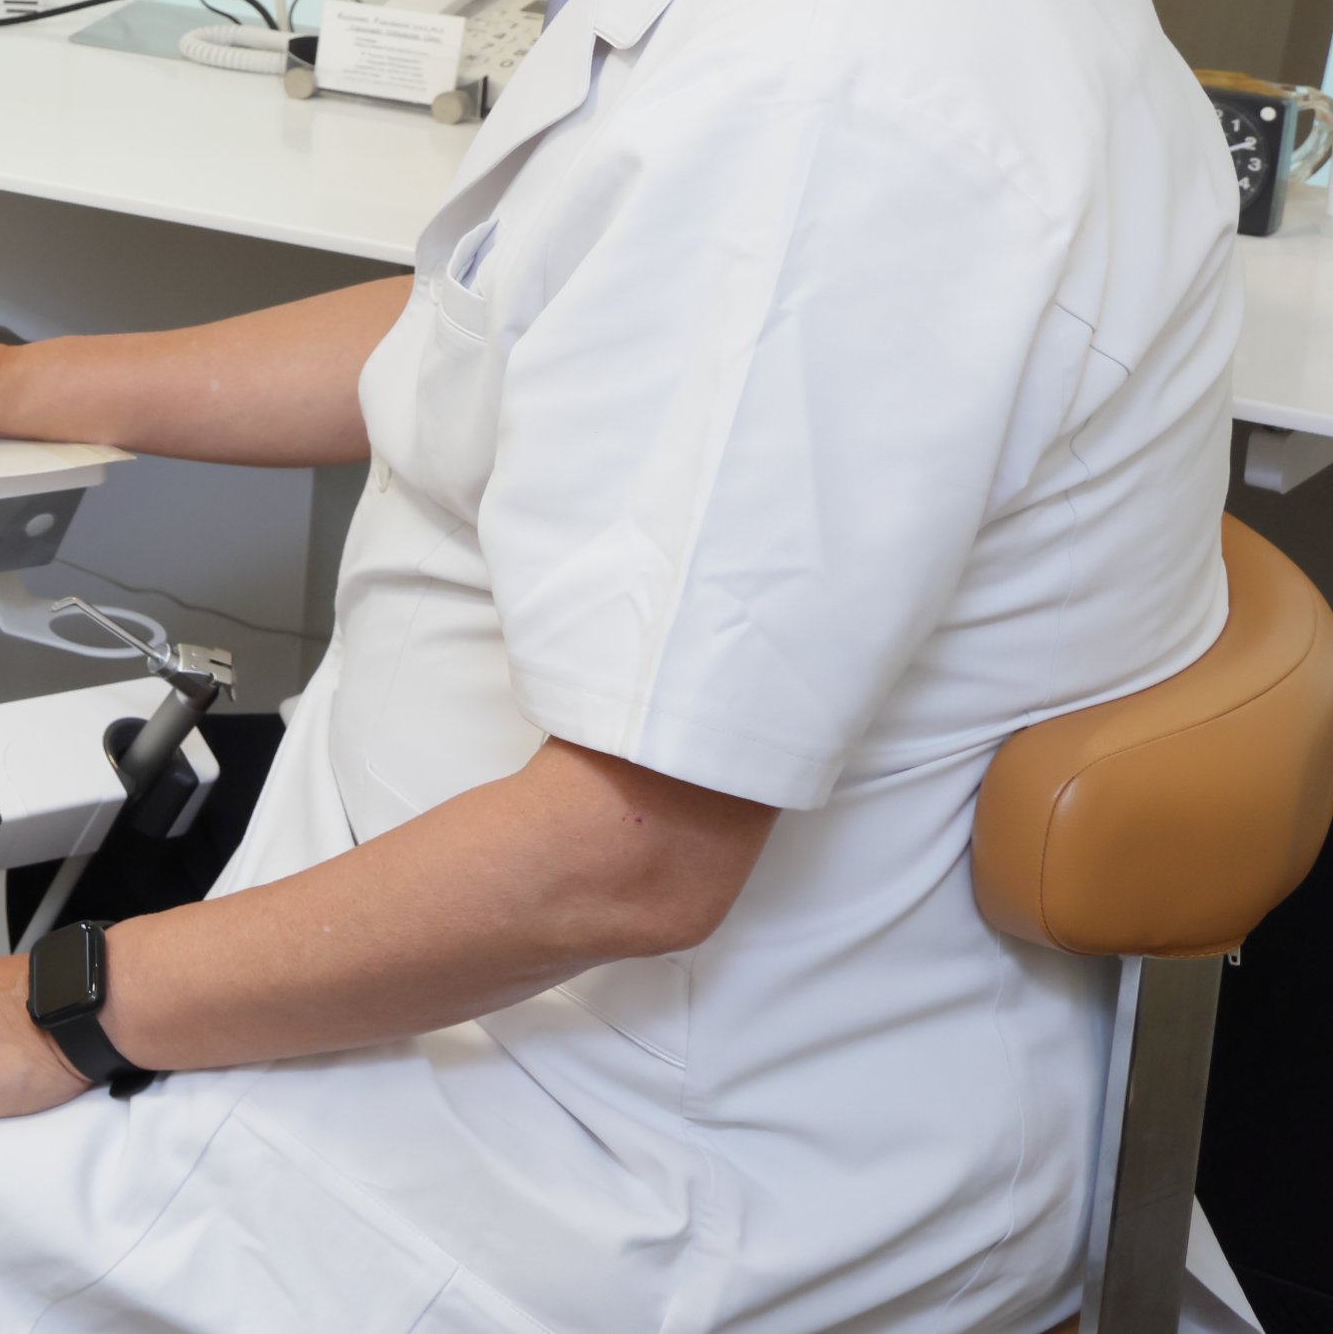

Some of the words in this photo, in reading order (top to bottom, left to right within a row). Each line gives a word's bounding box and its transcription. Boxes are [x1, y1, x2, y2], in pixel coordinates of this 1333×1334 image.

[1231, 119, 1241, 132] 1
[1247, 157, 1262, 172] 3
[1238, 176, 1251, 190] 4
